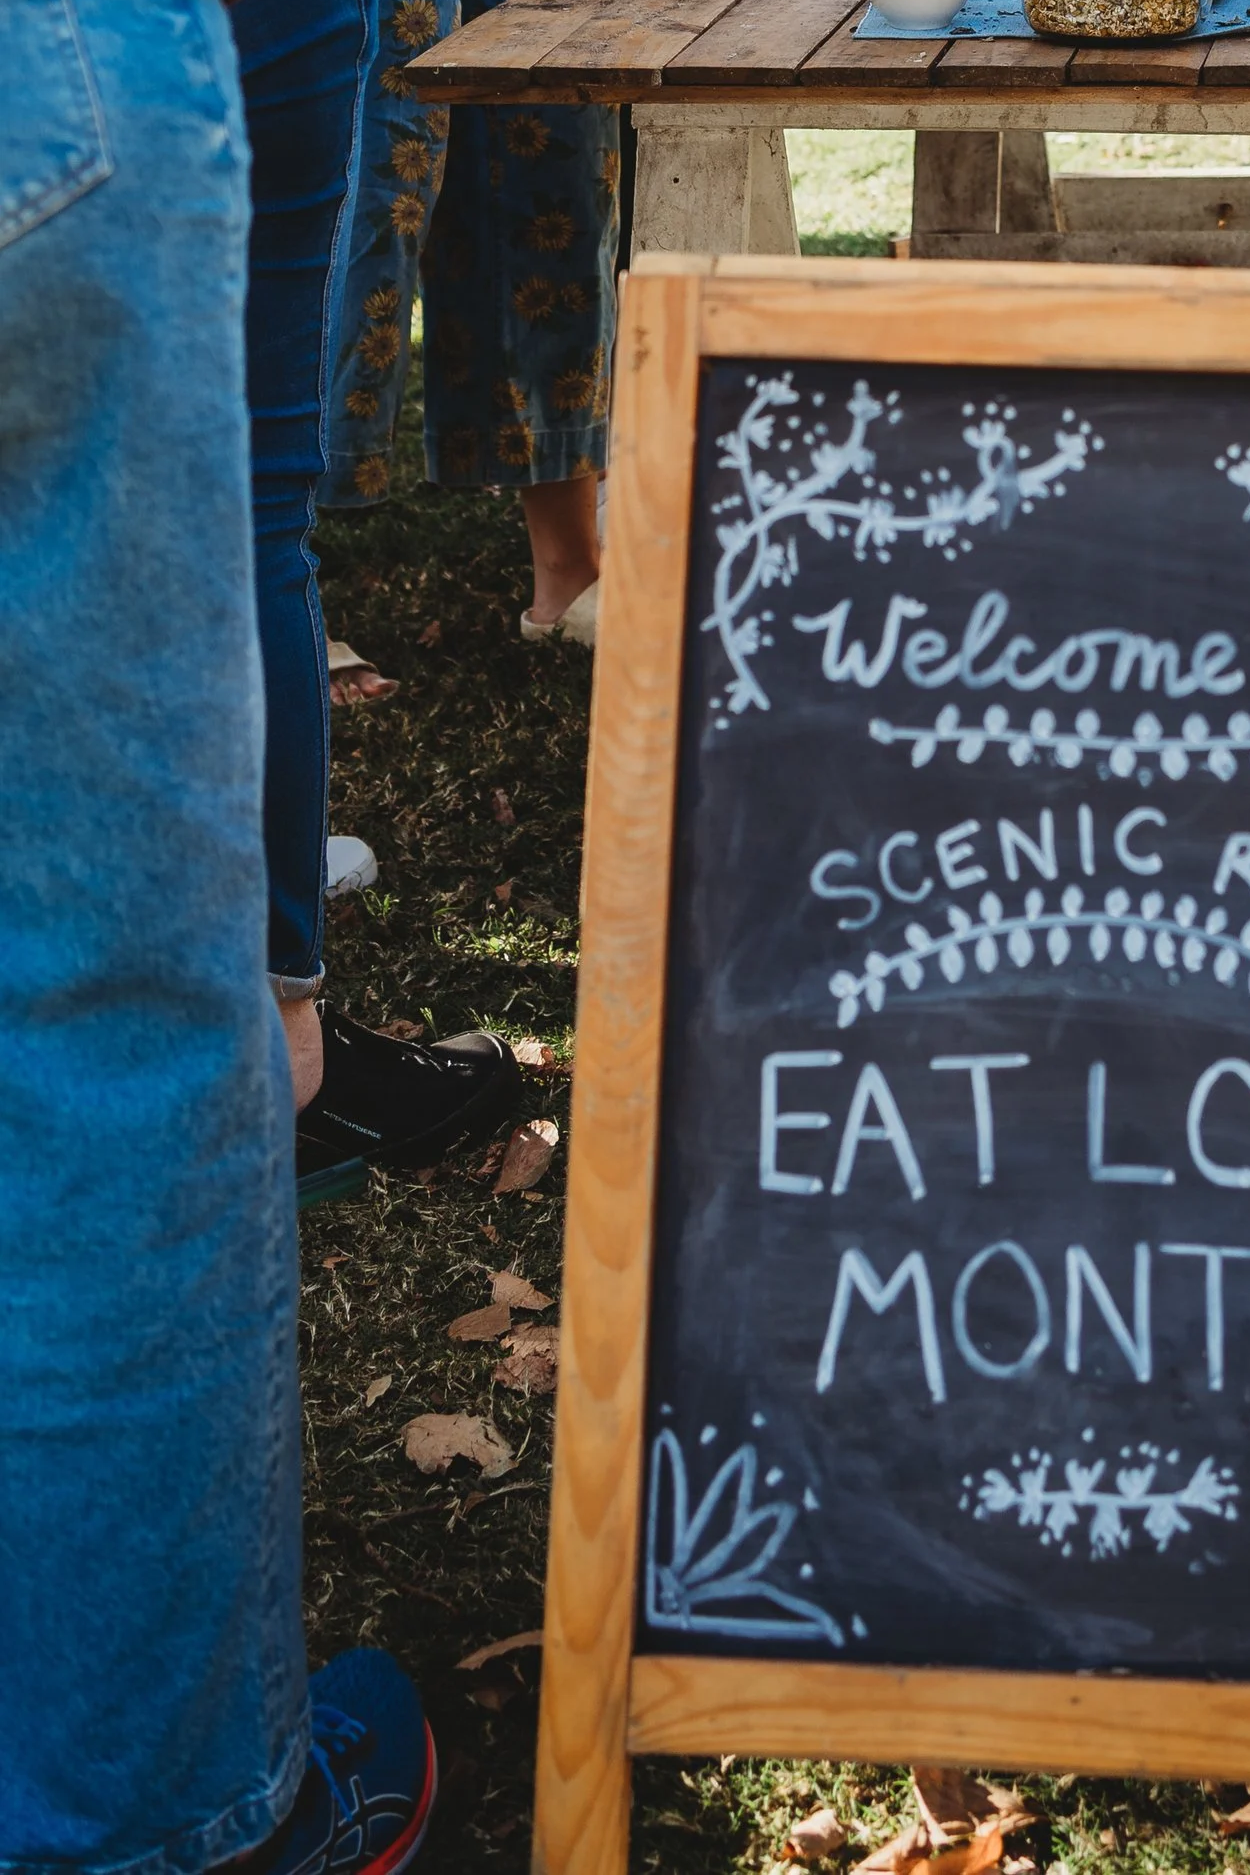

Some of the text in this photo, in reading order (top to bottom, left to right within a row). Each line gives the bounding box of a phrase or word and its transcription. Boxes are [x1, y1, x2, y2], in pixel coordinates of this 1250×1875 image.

[792, 590, 1246, 698] Welcome
[810, 804, 1167, 930] SCENIC
[759, 1050, 1031, 1201] EAT
